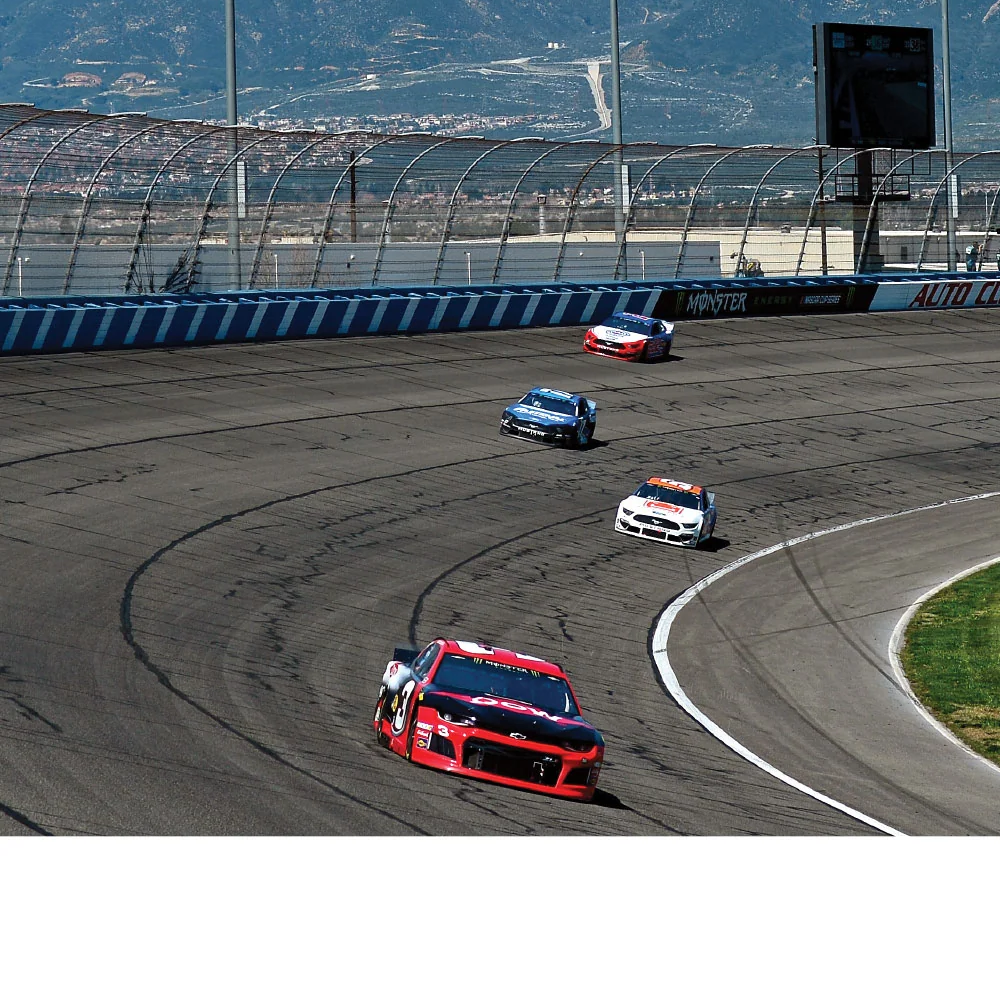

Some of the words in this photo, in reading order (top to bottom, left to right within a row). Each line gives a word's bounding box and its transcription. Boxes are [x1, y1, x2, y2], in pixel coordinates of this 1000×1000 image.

[686, 289, 747, 316] MONSTER
[909, 282, 972, 308] AUTO
[437, 724, 450, 738] 3
